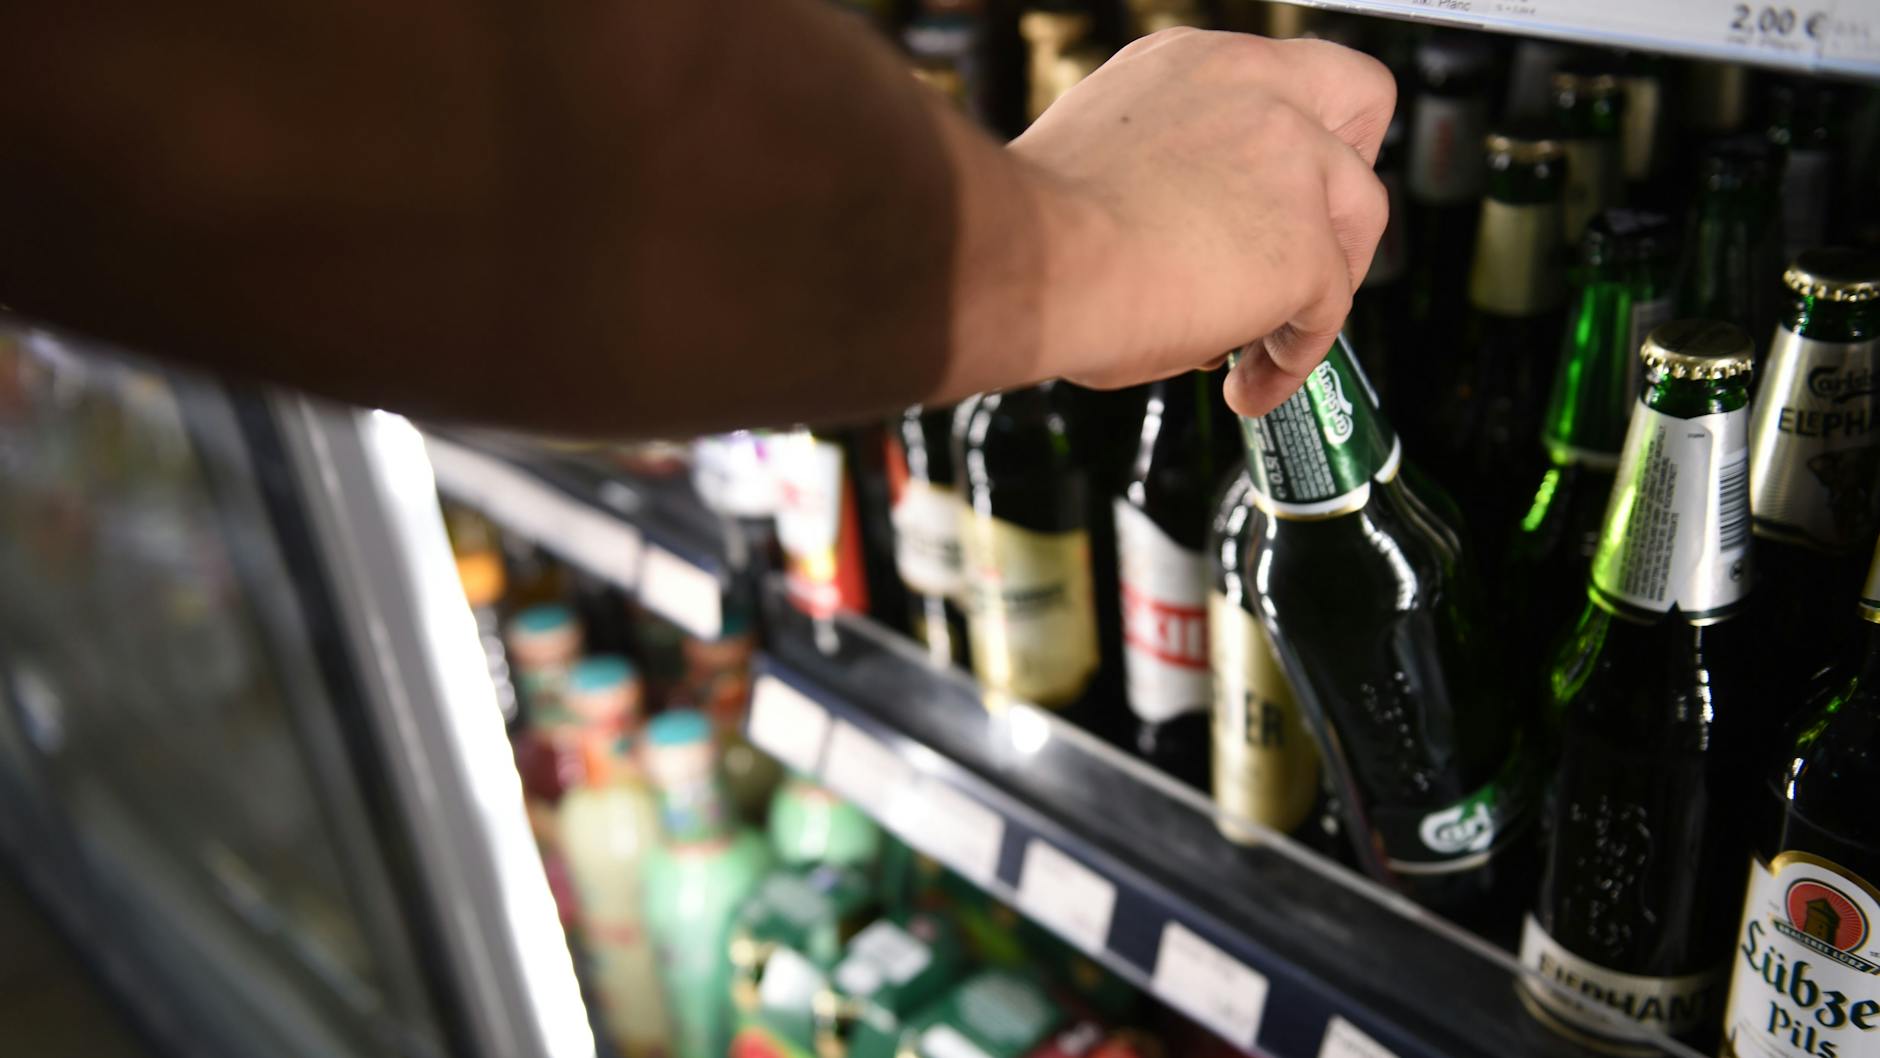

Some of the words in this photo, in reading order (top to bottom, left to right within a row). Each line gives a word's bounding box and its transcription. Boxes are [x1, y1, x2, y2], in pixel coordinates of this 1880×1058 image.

[1730, 3, 1797, 35] 2,00
[1804, 11, 1828, 39] €
[1314, 360, 1354, 446] Carlsberg
[1419, 802, 1493, 853] Carl
[1742, 919, 1880, 1031] Lübze
[1767, 1000, 1838, 1058] Pils
